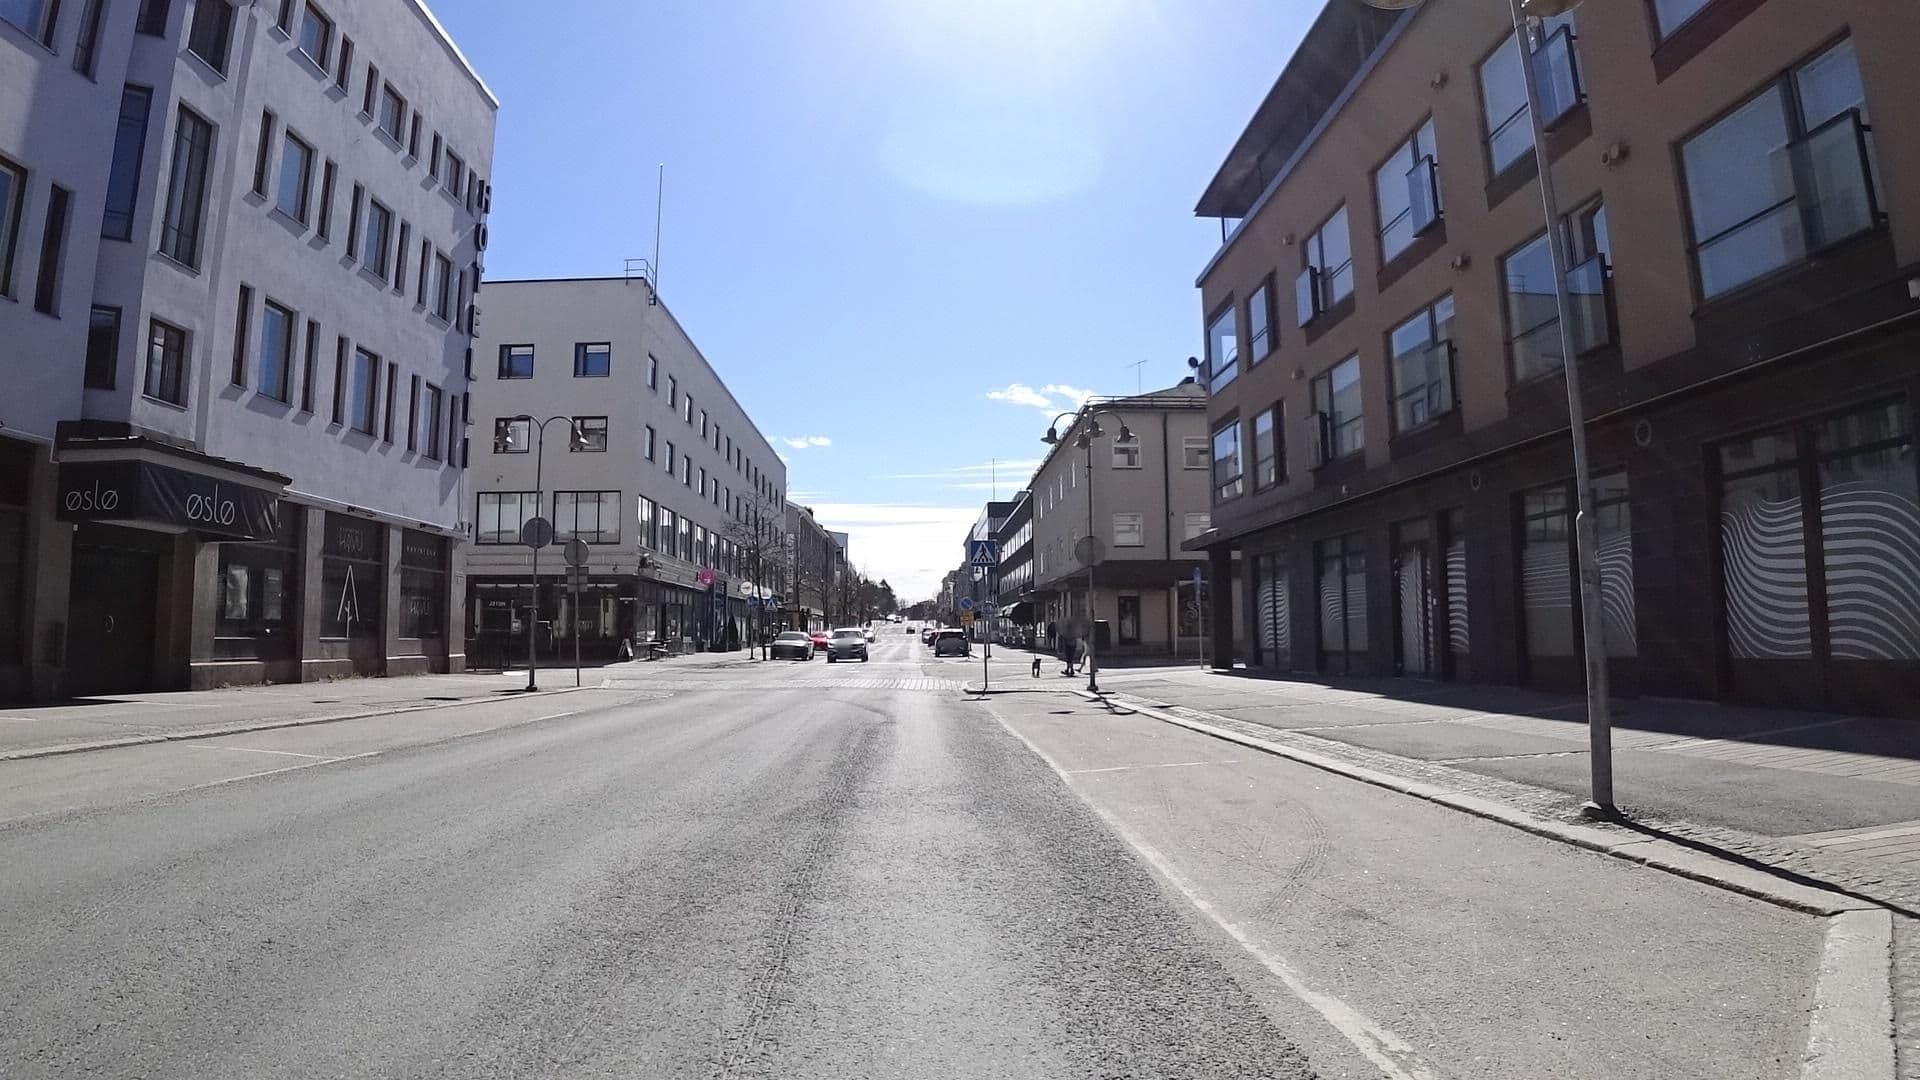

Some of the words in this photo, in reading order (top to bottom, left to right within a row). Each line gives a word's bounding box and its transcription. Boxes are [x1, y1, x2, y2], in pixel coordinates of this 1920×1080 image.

[462, 179, 491, 468] HOTELLI
[65, 479, 119, 511] øslø
[186, 483, 236, 526] øslø
